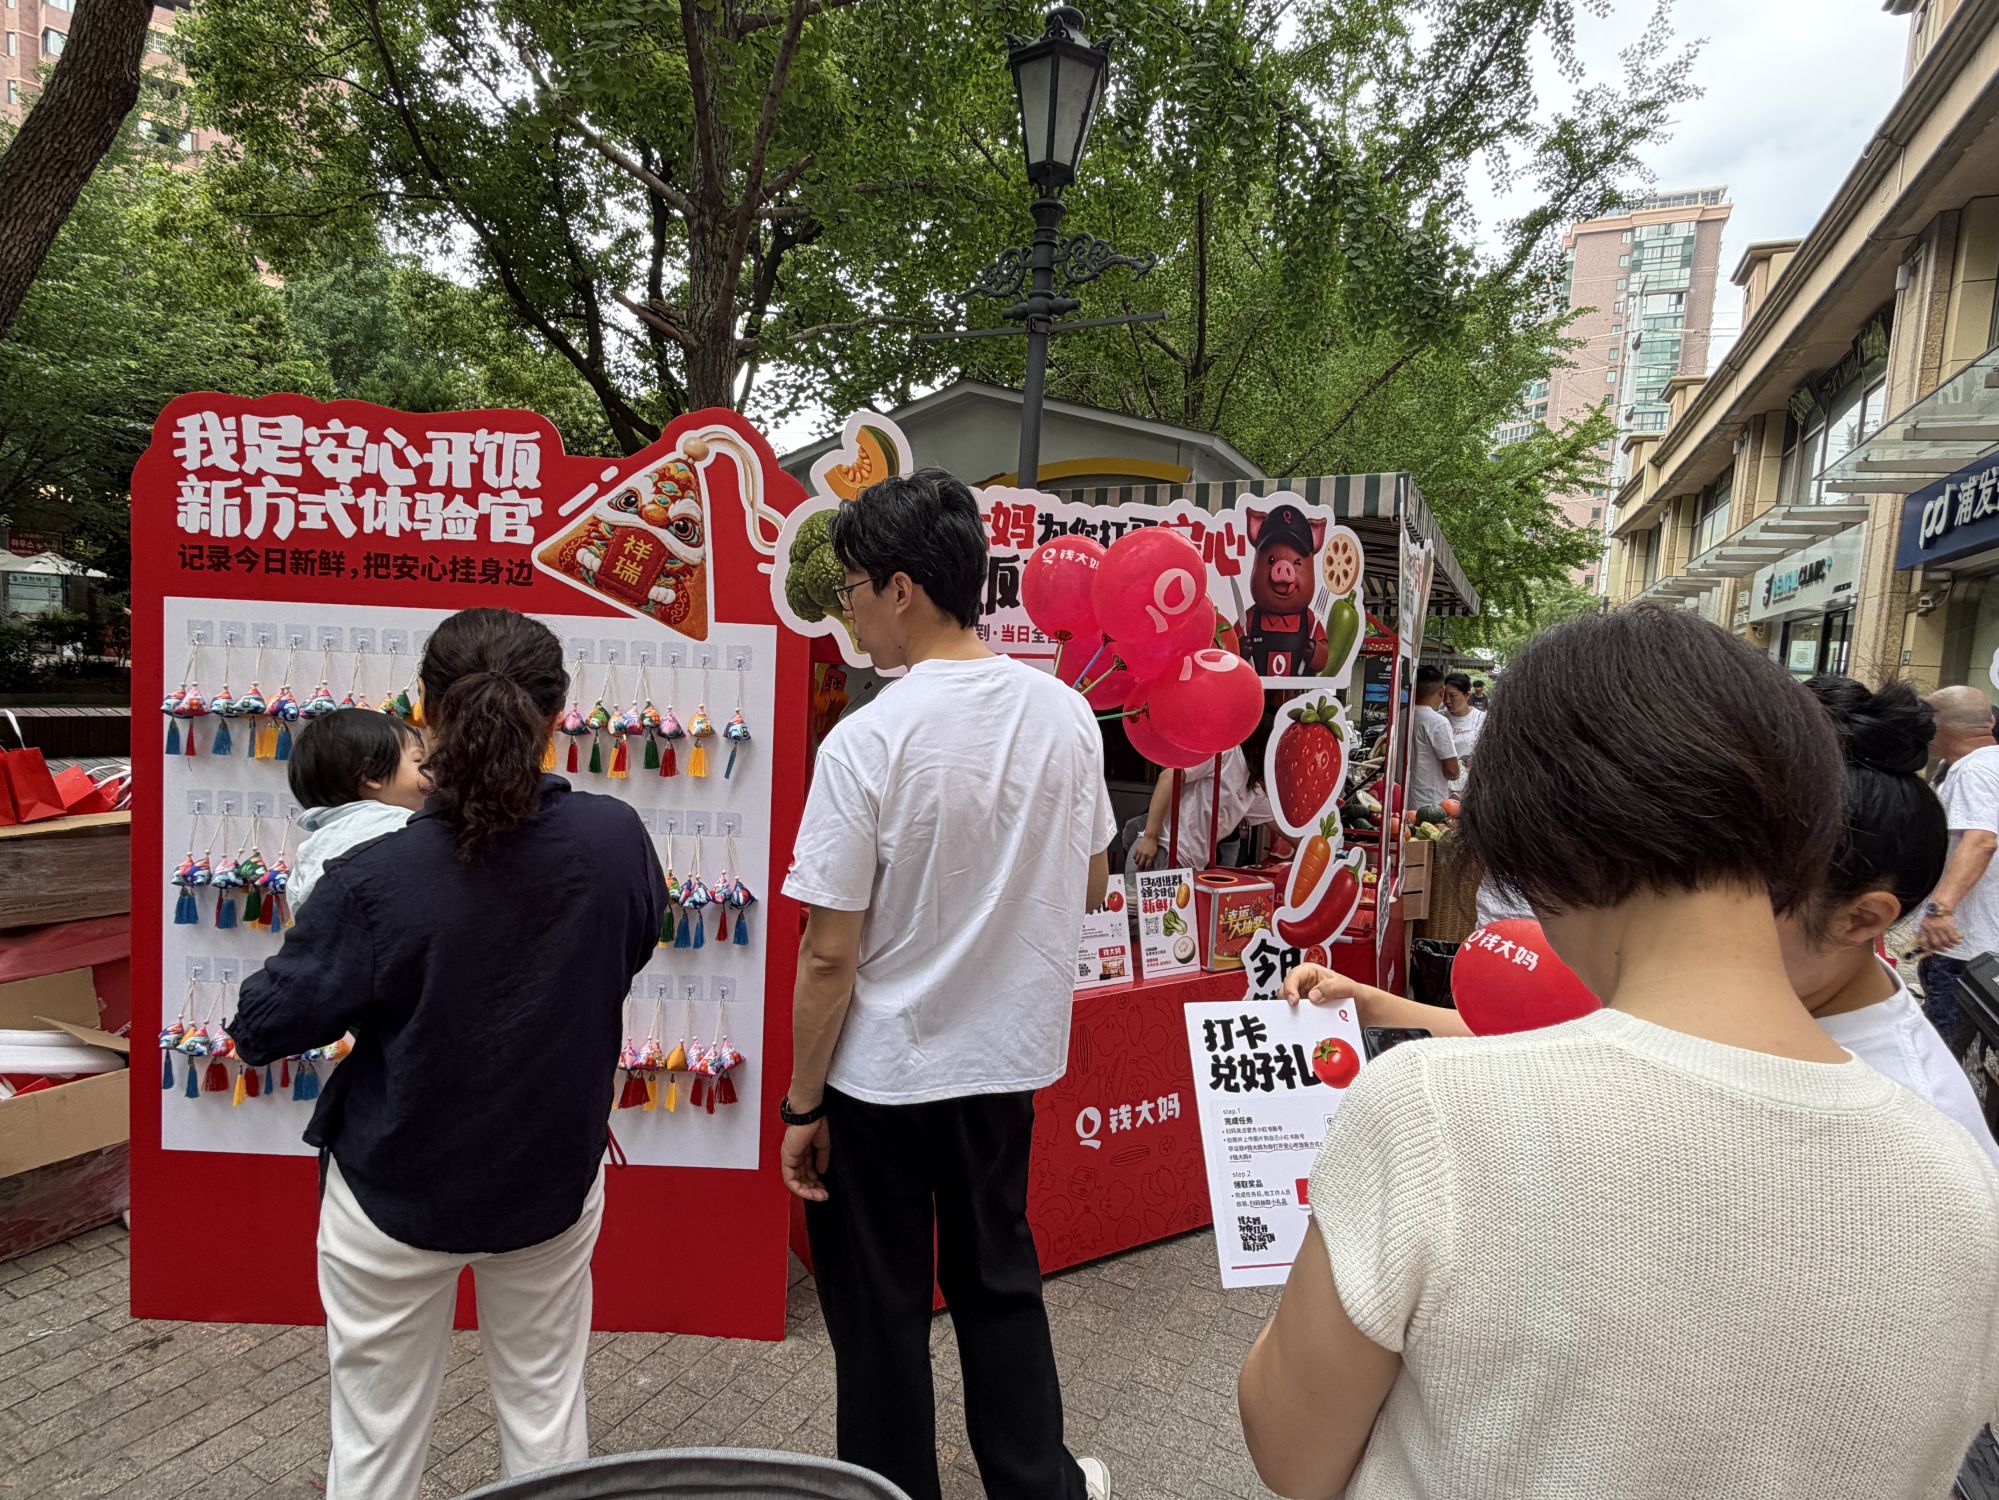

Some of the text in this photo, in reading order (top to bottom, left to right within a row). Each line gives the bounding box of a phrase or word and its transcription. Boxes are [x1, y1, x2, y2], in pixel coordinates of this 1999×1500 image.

[173, 411, 541, 489] 我是安心开饭
[177, 474, 543, 545] 新方式体验官
[1478, 933, 1540, 972] 钱大妈
[1203, 1014, 1267, 1052] 打卡
[1209, 1043, 1321, 1093] 兑好礼
[1109, 1092, 1180, 1134] 钱大妈
[1224, 1117, 1253, 1125] 完成任务
